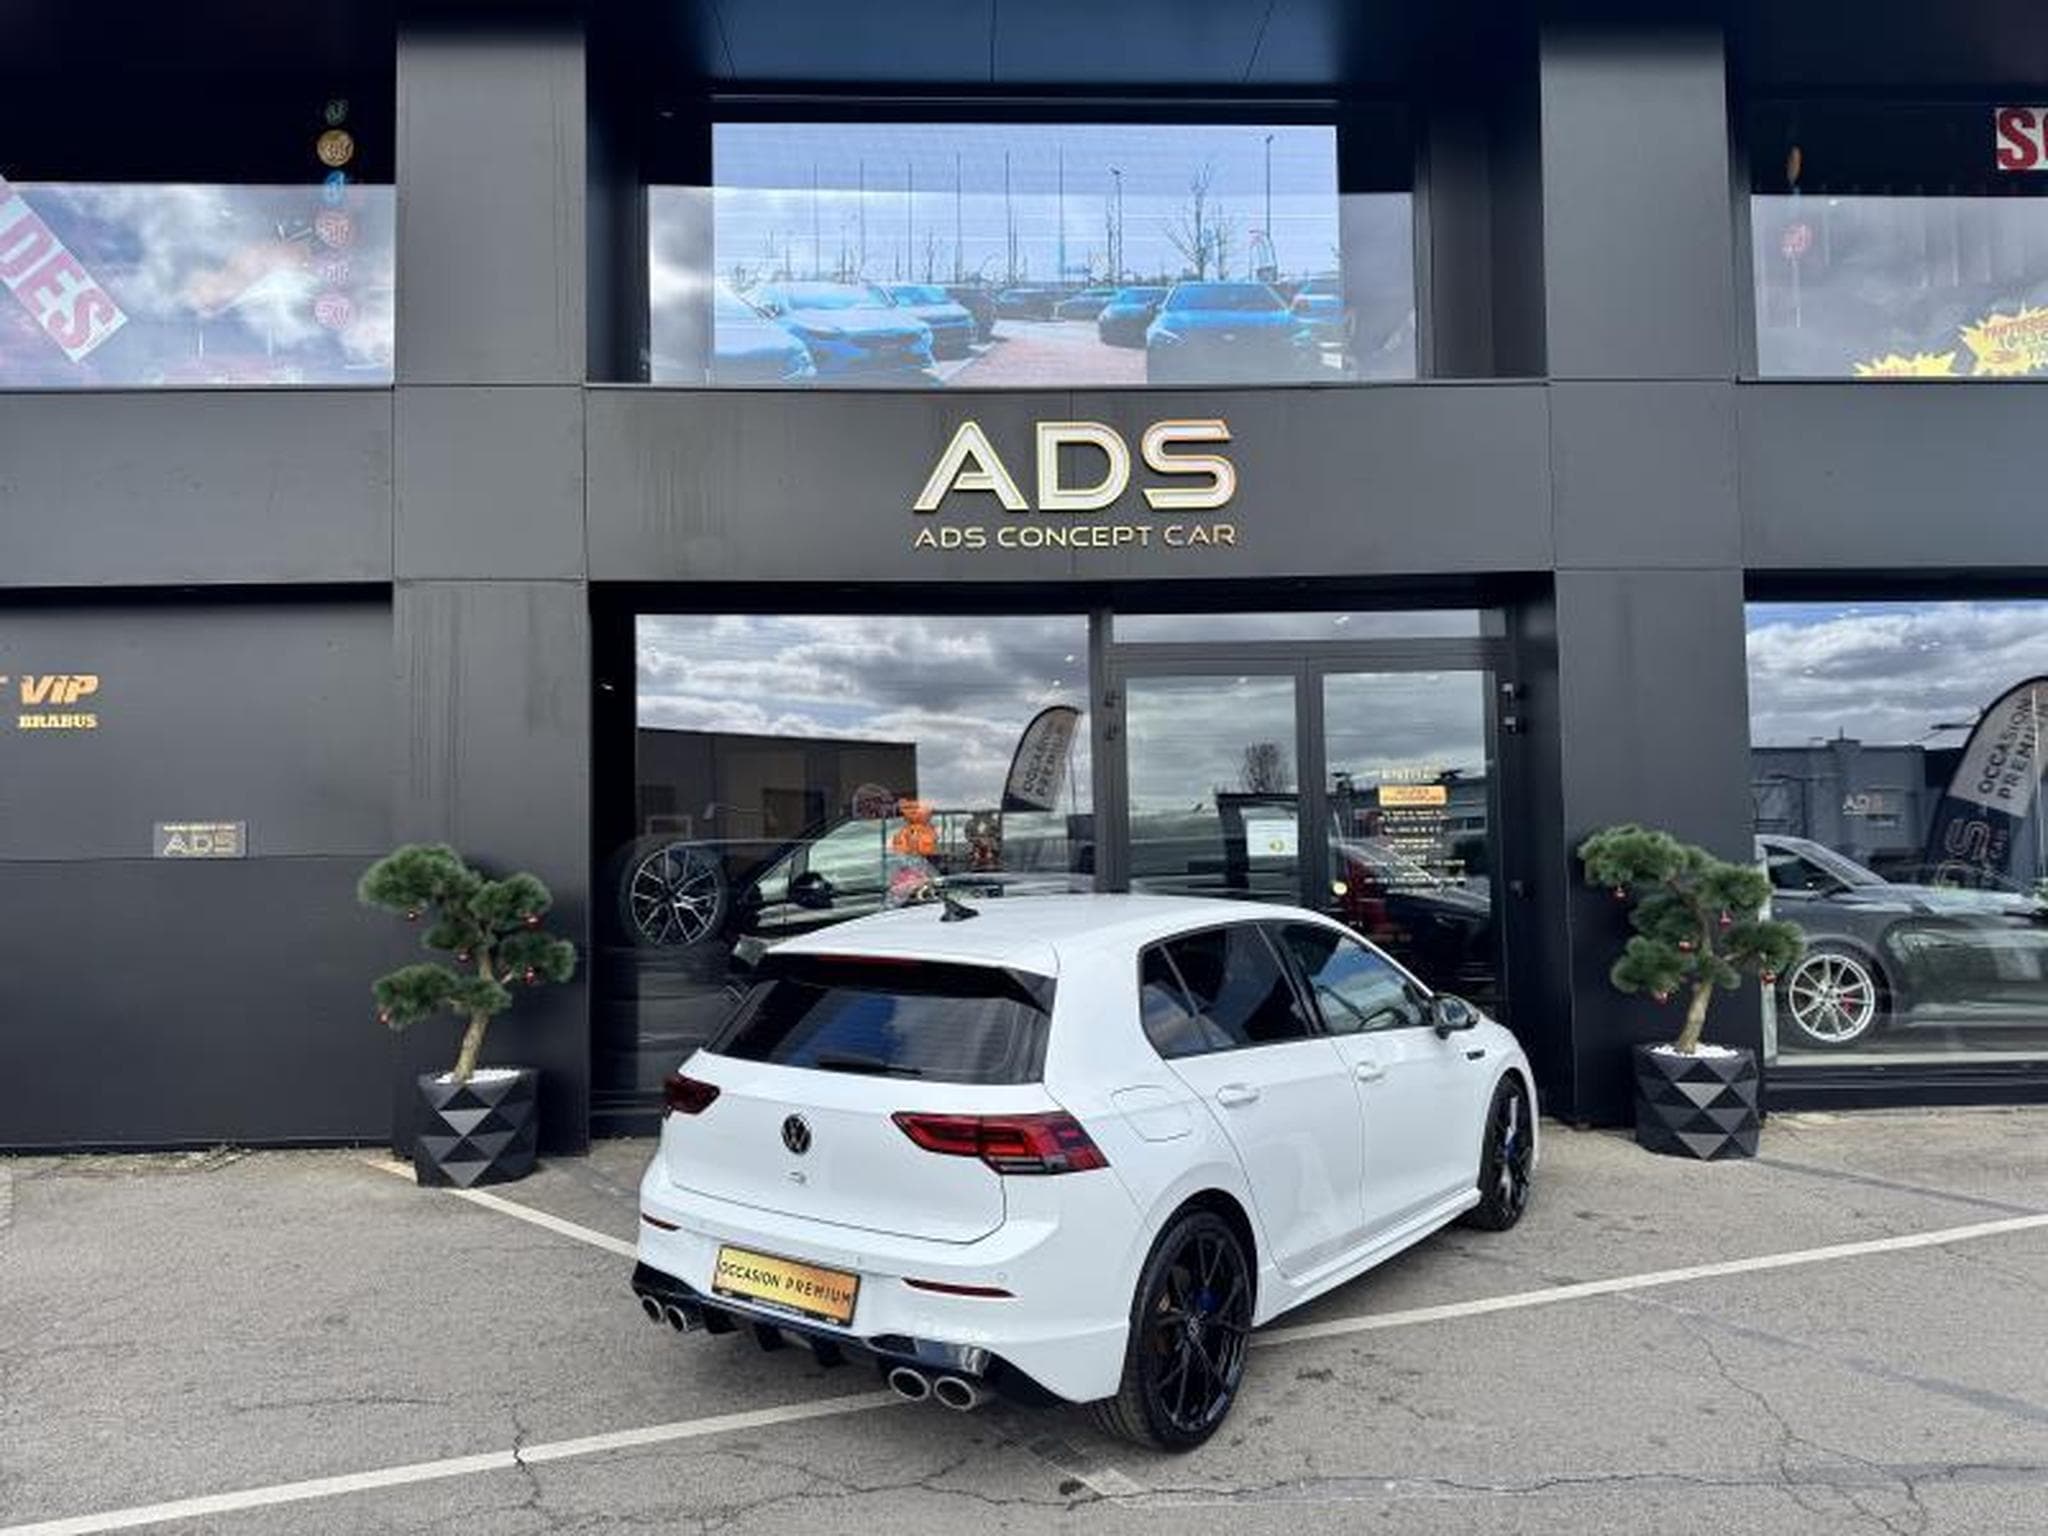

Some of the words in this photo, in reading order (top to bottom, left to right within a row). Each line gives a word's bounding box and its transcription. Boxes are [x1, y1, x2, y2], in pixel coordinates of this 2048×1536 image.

[1998, 109, 2048, 169] S
[0, 174, 115, 348] DES
[913, 419, 1237, 511] ADS
[914, 527, 986, 549] ADS
[997, 526, 1153, 548] CONCEPT
[1164, 524, 1237, 546] CAR
[19, 714, 98, 728] BRABUS
[163, 832, 236, 856] ADS
[719, 1262, 781, 1287] OCCASION
[785, 1279, 851, 1307] PREMIUM
